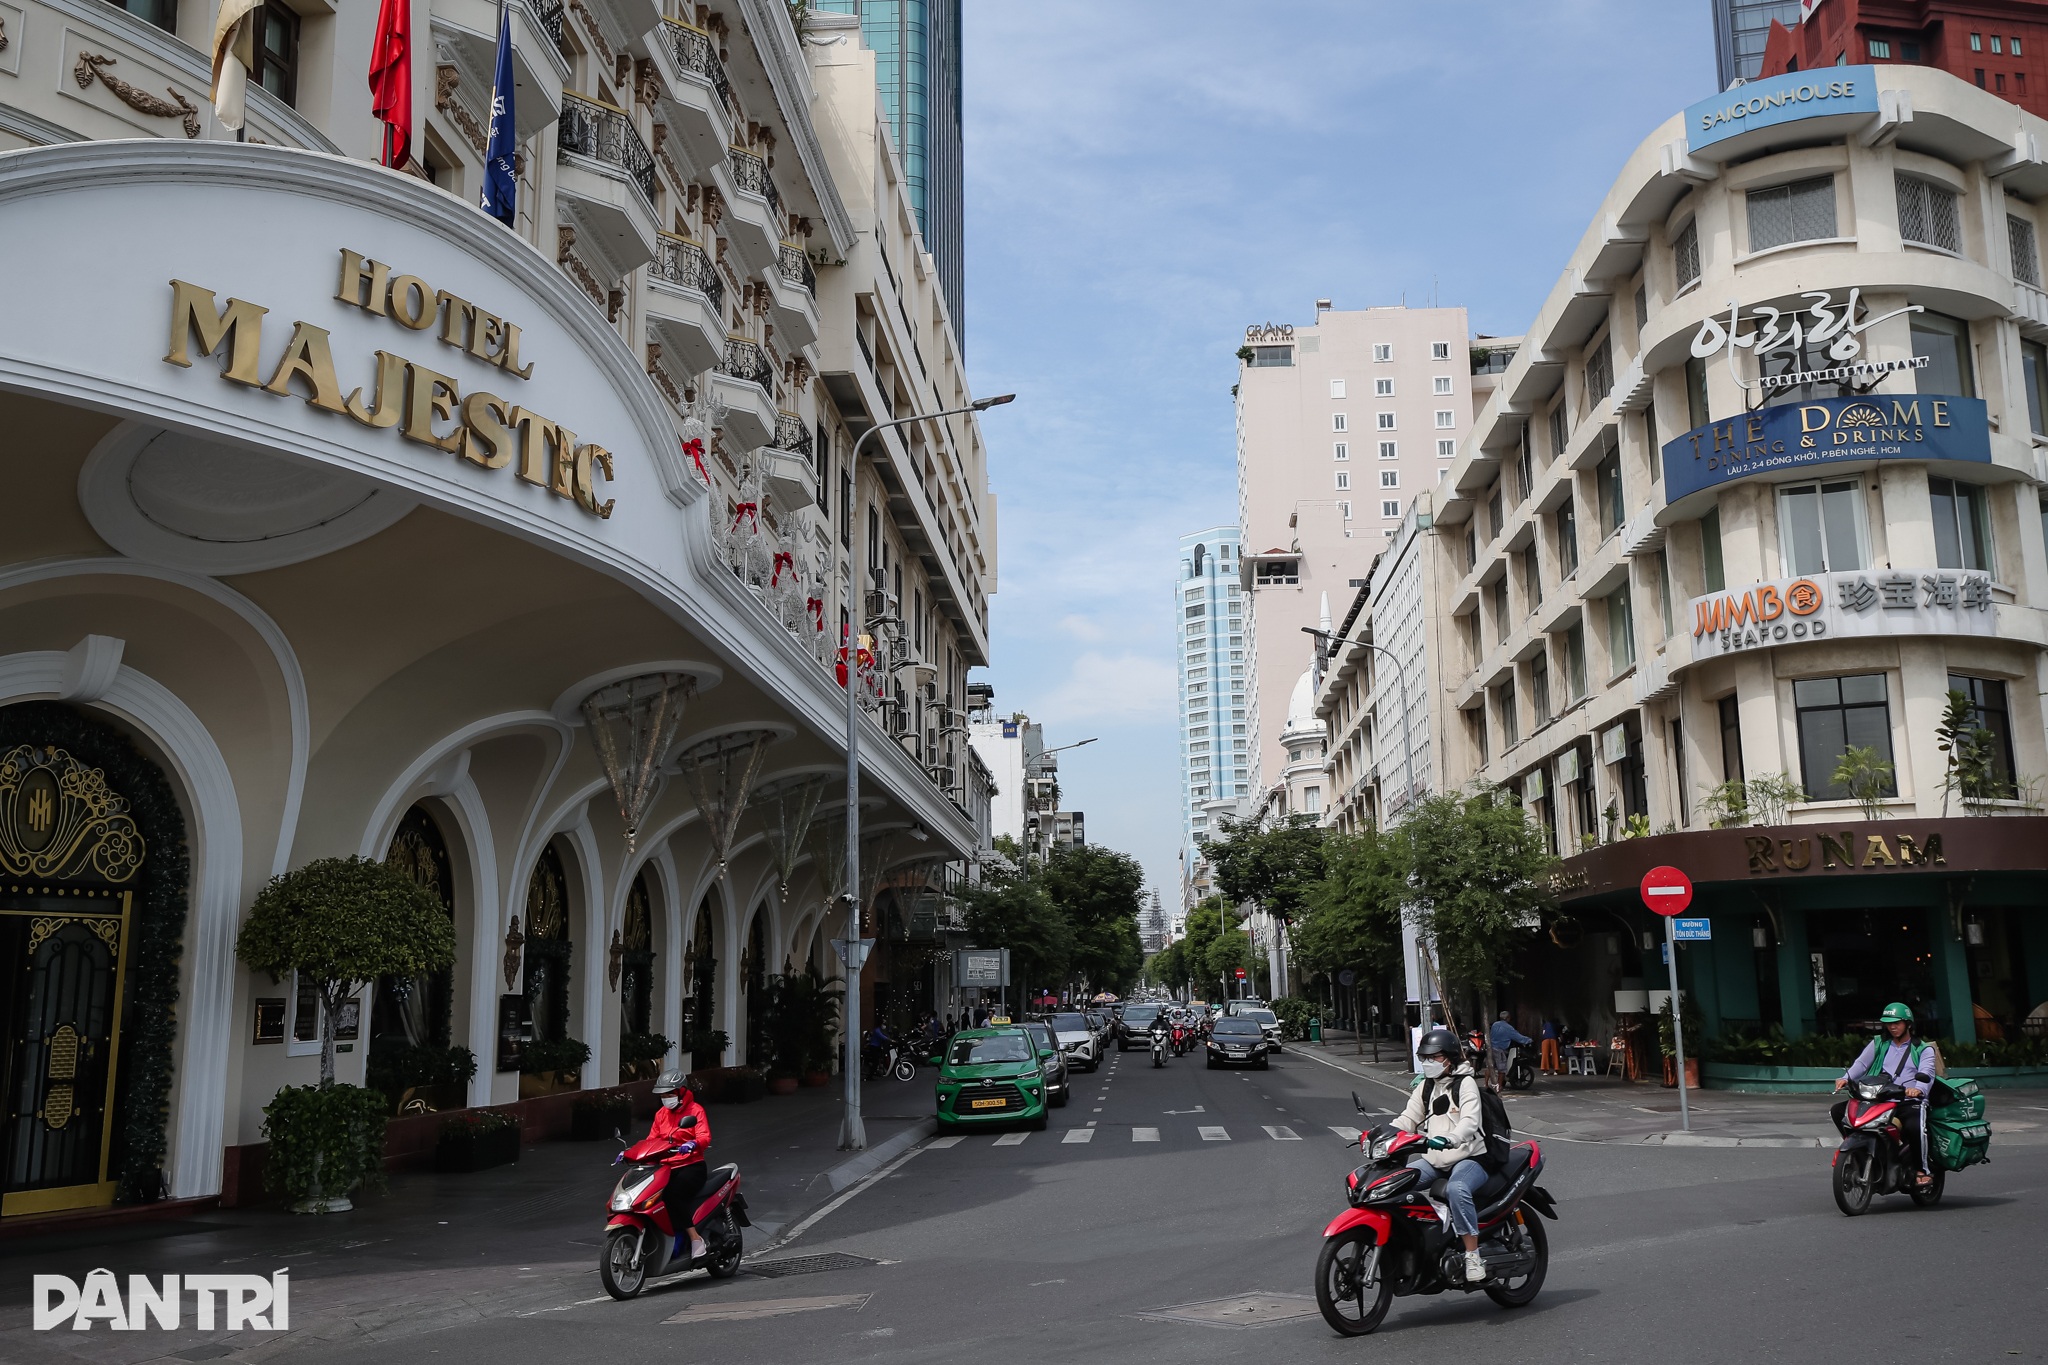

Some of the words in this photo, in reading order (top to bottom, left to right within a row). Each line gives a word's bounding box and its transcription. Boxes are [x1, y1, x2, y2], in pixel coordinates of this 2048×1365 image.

[1701, 81, 1855, 130] SAIGONHOUSE
[334, 247, 535, 380] HOTEL
[1246, 321, 1294, 337] GRAND
[1691, 288, 1925, 389] 아리랑
[1758, 371, 1820, 388] KOREAN
[1827, 356, 1929, 380] RESTAURANT
[162, 279, 616, 520] MAJESTIC
[1688, 415, 1766, 460] THE
[1707, 439, 1785, 470] DINING
[1799, 435, 1816, 448] &
[1833, 428, 1924, 445] DRINKS
[1752, 461, 1764, 469] 2-4
[1881, 446, 1901, 454] HCM
[1693, 579, 1823, 638] JUMBO
[1721, 620, 1826, 650] SEAFOOD
[1745, 831, 1947, 873] RUNAM
[1676, 929, 1685, 937] TÔN
[1686, 928, 1694, 937] ĐỨC
